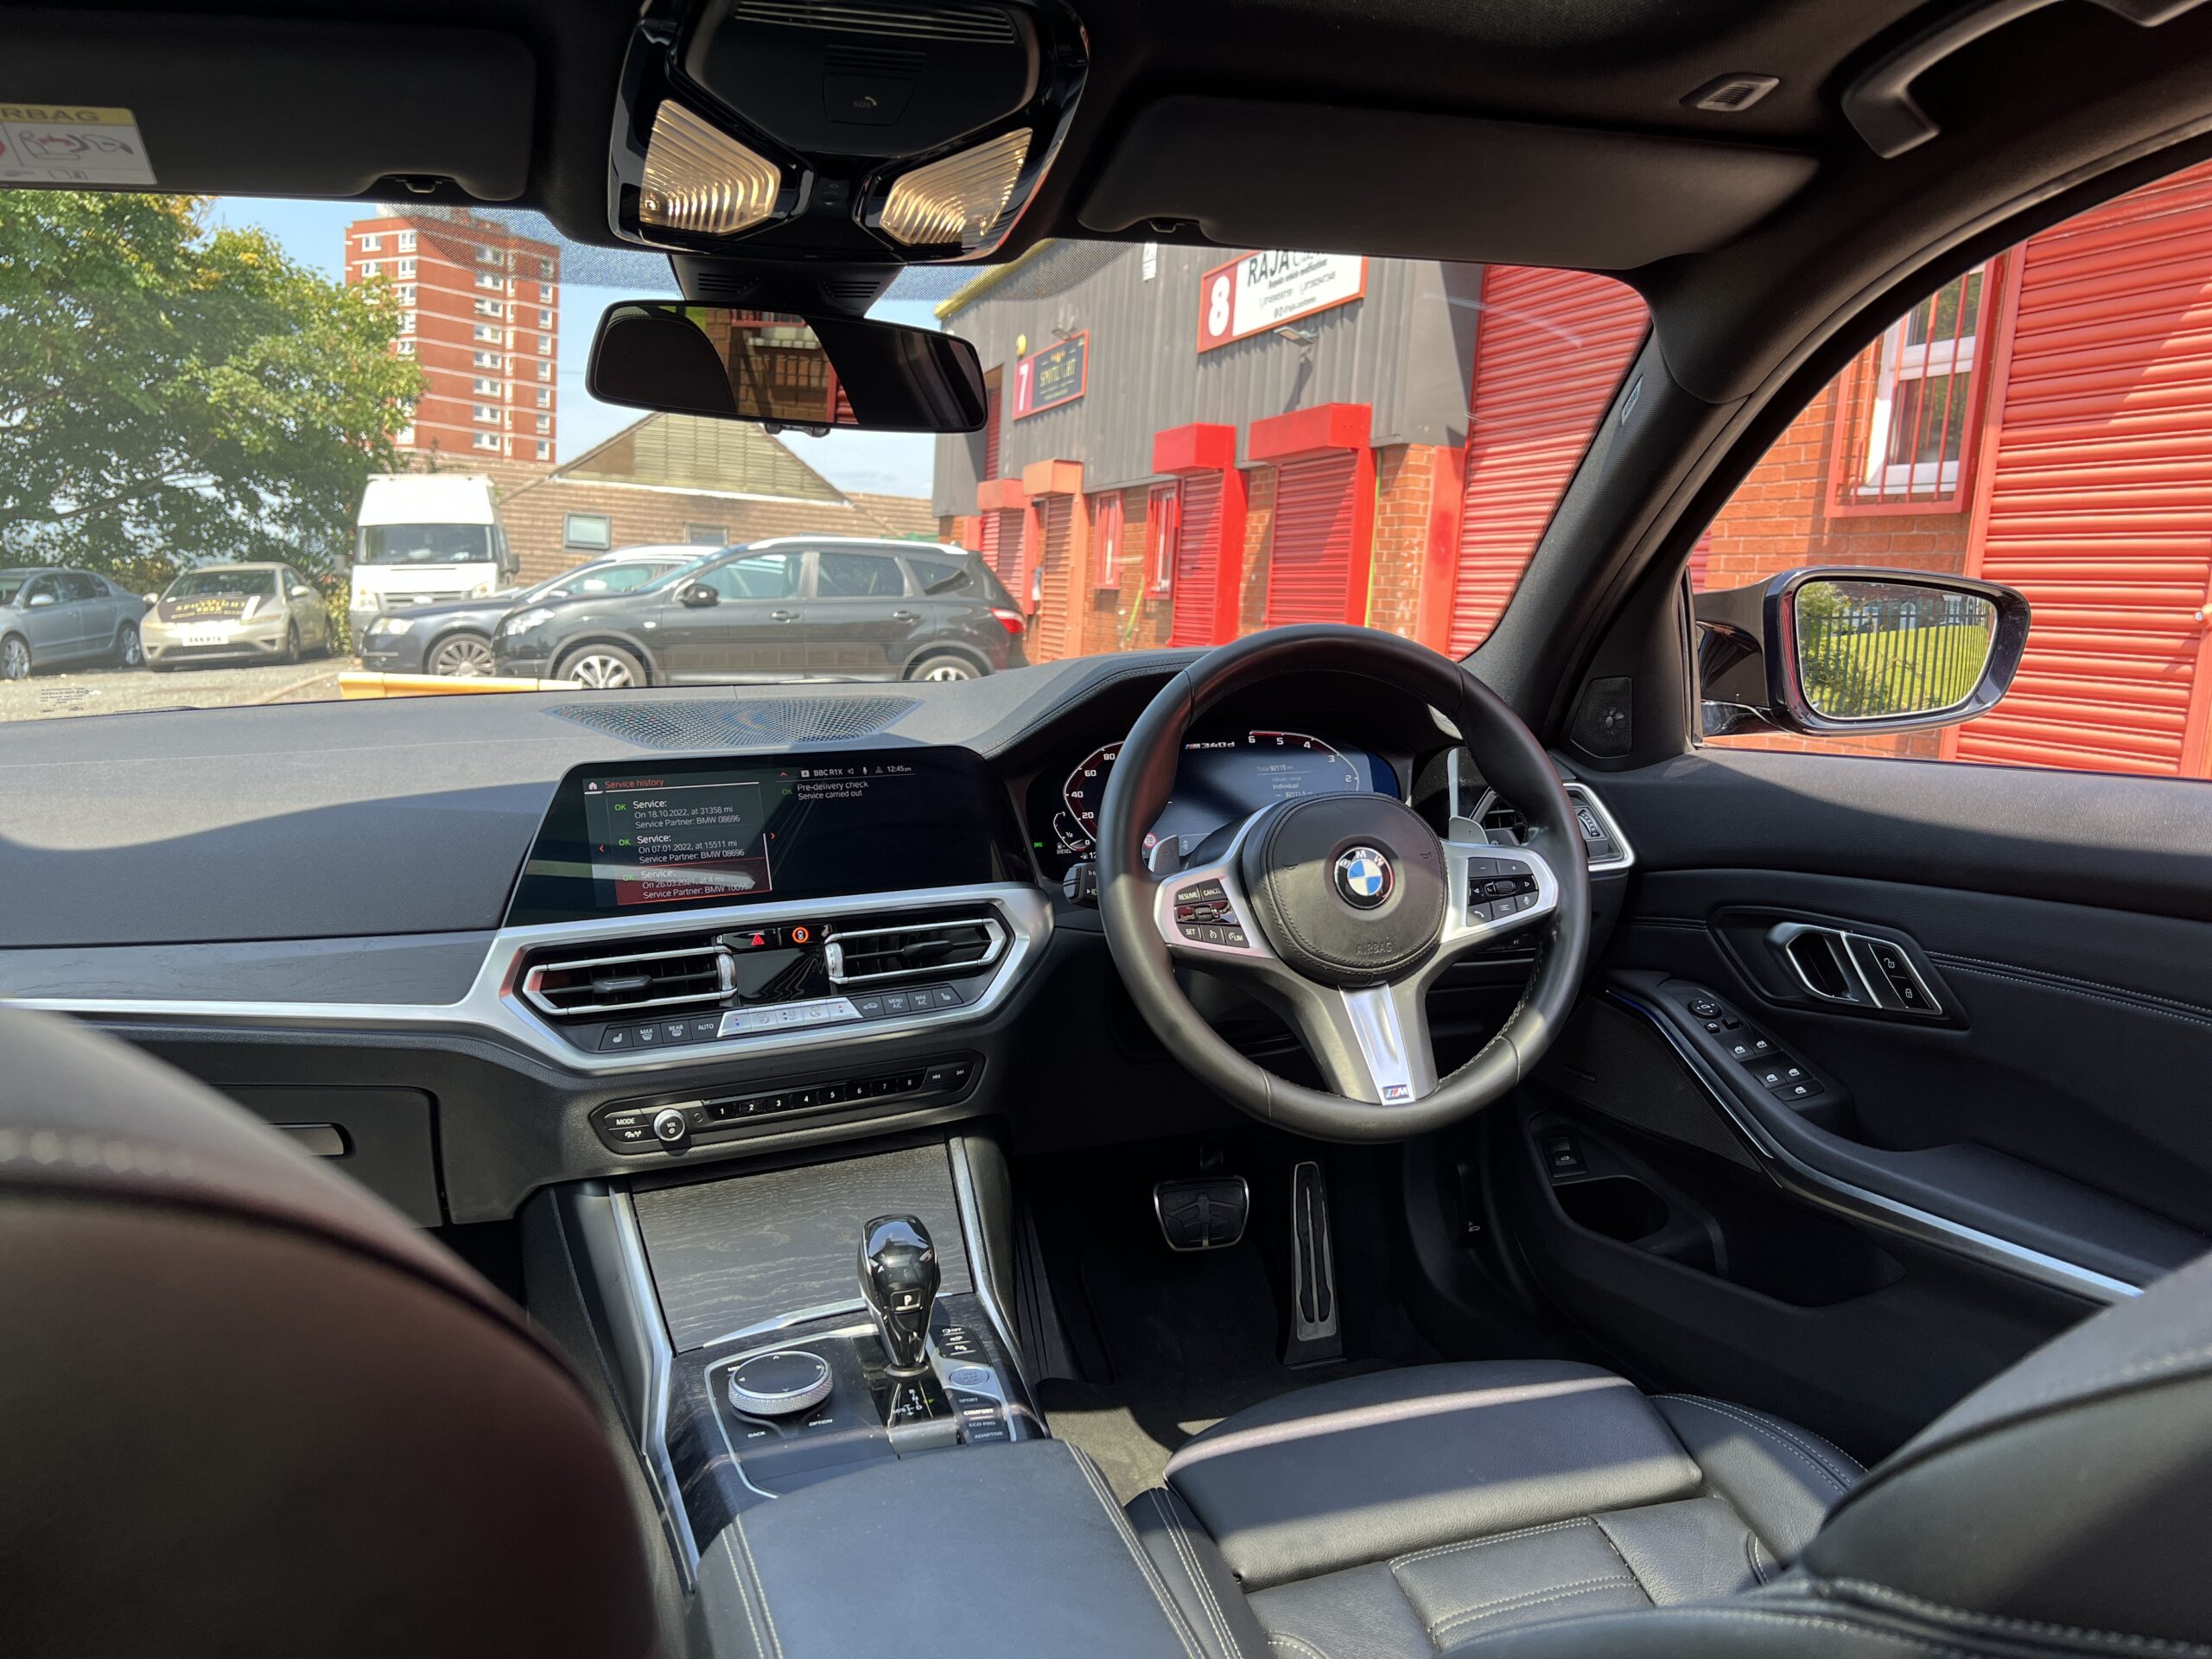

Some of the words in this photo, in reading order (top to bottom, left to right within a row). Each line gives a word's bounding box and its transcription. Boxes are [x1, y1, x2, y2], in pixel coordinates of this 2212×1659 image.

[1, 108, 100, 121] RBAG
[1247, 250, 1288, 287] RAJA
[1208, 276, 1230, 337] 8
[1018, 363, 1029, 411] 7
[605, 779, 634, 789] Service
[636, 778, 664, 788] history
[797, 783, 843, 792] Pre-delivery
[845, 780, 869, 788] check
[798, 792, 823, 801] Service
[825, 790, 849, 798] carried
[633, 800, 667, 809] Service:
[648, 808, 689, 818] 18.10.2022,
[636, 820, 663, 829] Service
[665, 818, 695, 826] Partner:
[637, 835, 671, 844] Service:
[638, 846, 650, 854] On
[652, 843, 694, 853] 07.01.2022,
[639, 855, 667, 864] Service
[669, 852, 699, 861] Partner:
[1339, 850, 1385, 870] BMW
[641, 870, 676, 879] Service:
[643, 890, 671, 899] Service
[673, 888, 702, 897] Partner:
[1178, 892, 1198, 901] RESUME
[1203, 888, 1222, 896] CANCEL
[1356, 942, 1393, 955] AIRBAG
[904, 1295, 912, 1306] P
